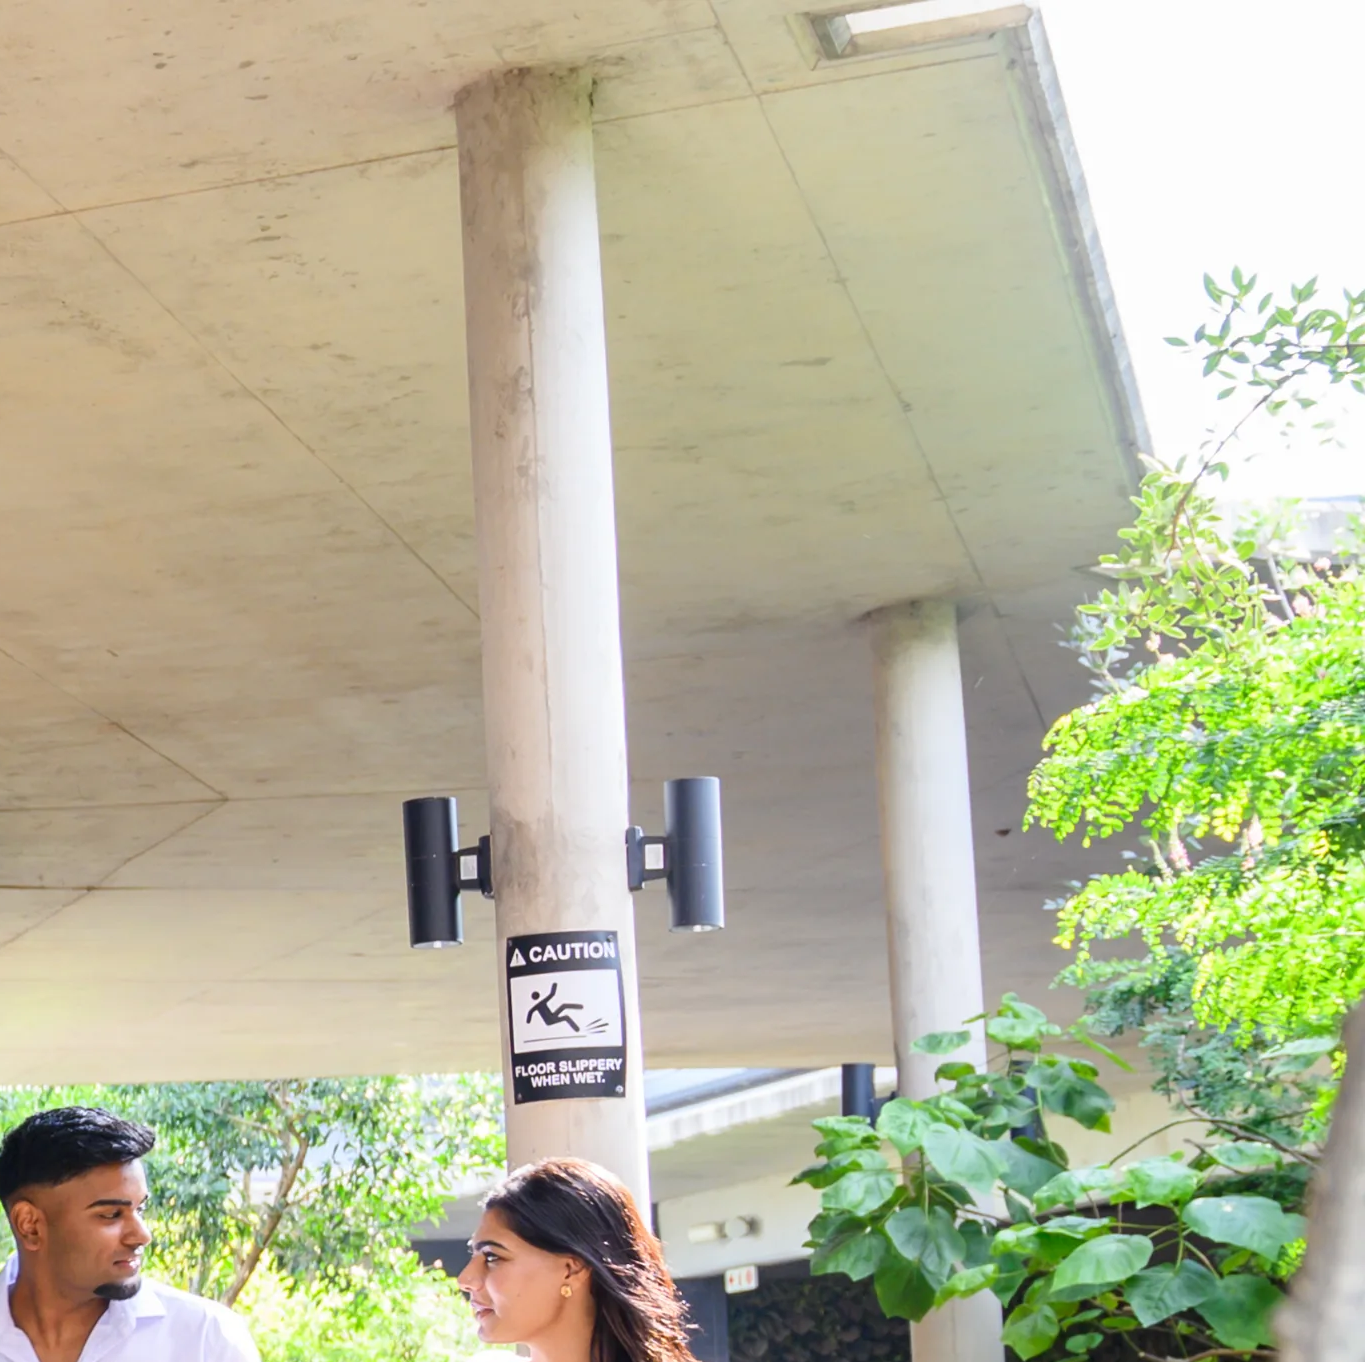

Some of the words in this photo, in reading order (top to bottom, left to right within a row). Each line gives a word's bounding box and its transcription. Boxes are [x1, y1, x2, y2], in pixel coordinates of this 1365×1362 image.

[528, 941, 616, 963] CAUTION
[514, 1061, 556, 1078] FLOOR
[558, 1058, 623, 1074] SLIPPERY
[530, 1072, 570, 1088] WHEN
[573, 1070, 606, 1085] WET.
